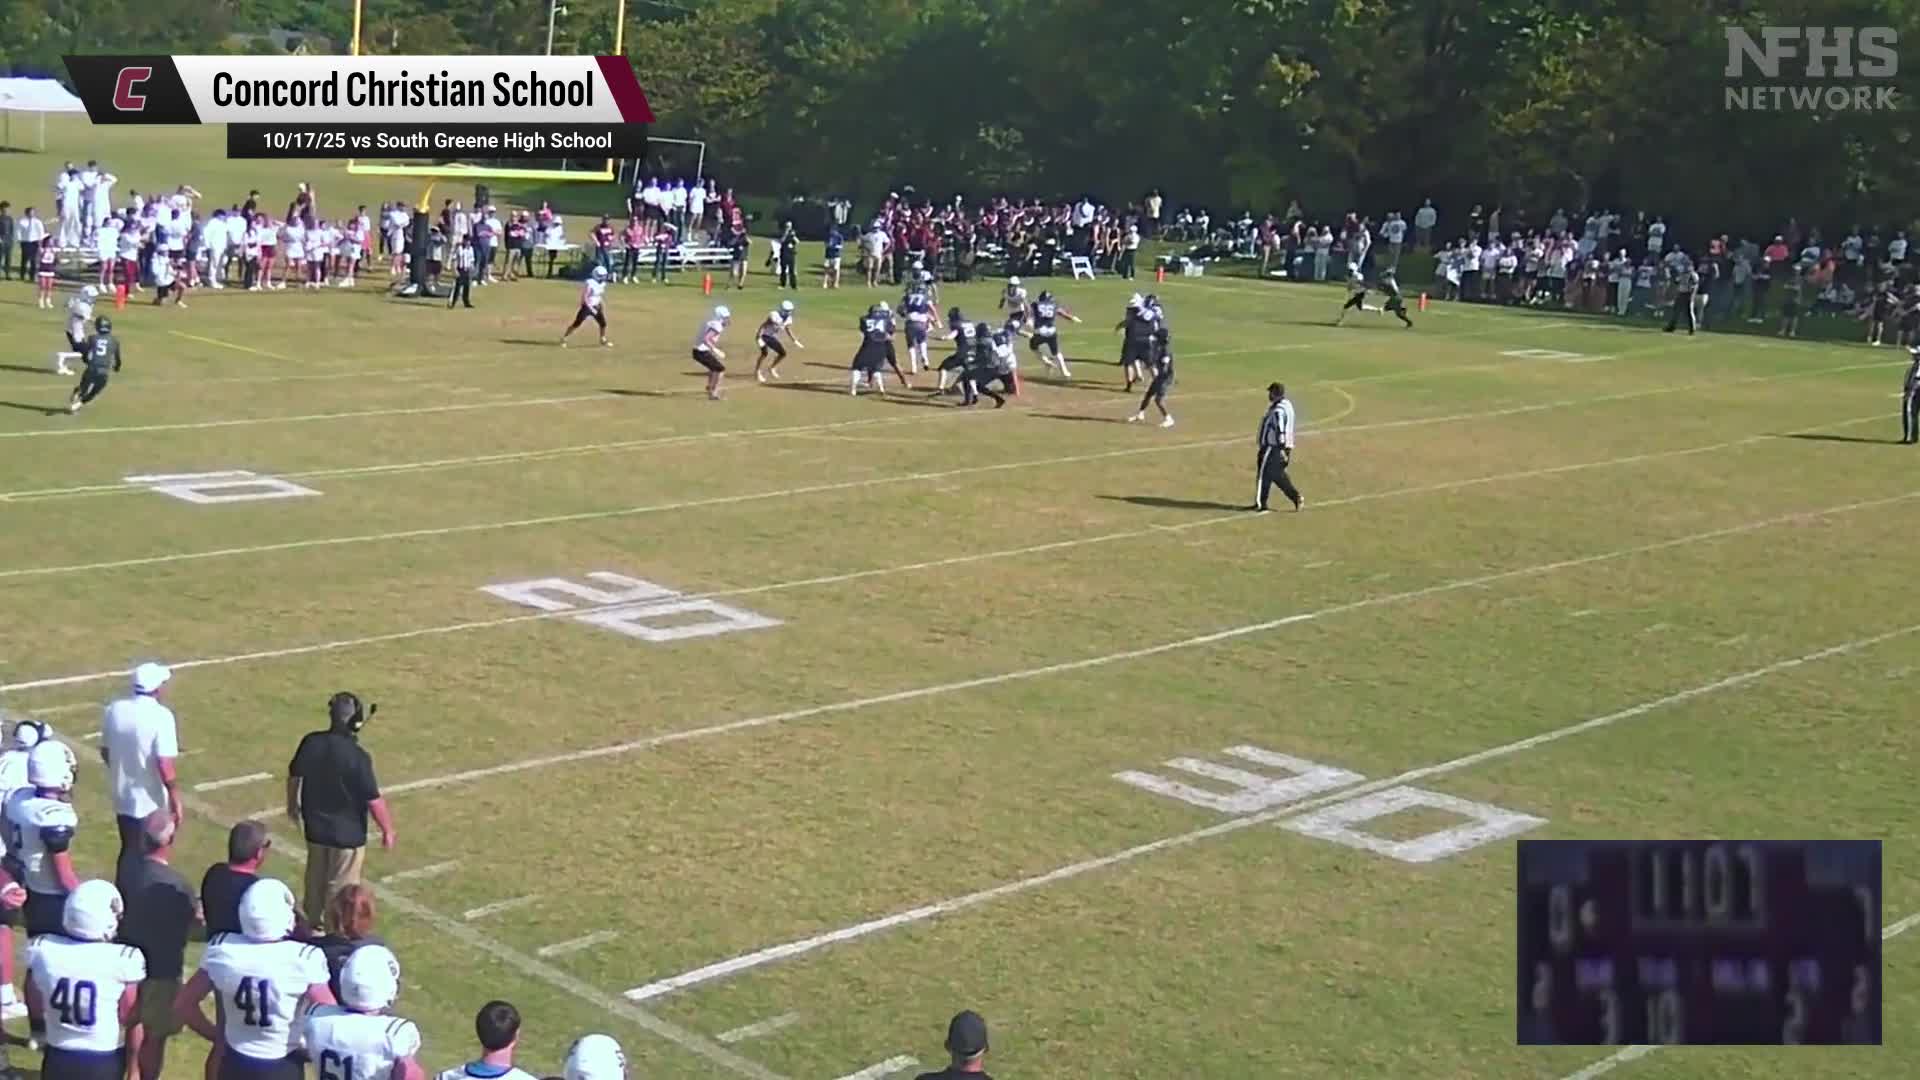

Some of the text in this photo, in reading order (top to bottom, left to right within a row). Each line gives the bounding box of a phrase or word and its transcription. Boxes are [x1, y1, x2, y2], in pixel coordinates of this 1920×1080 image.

[865, 318, 886, 332] 54
[96, 338, 108, 356] 5
[50, 978, 97, 1026] 40
[233, 976, 275, 1027] 41
[319, 1048, 354, 1080] 61
